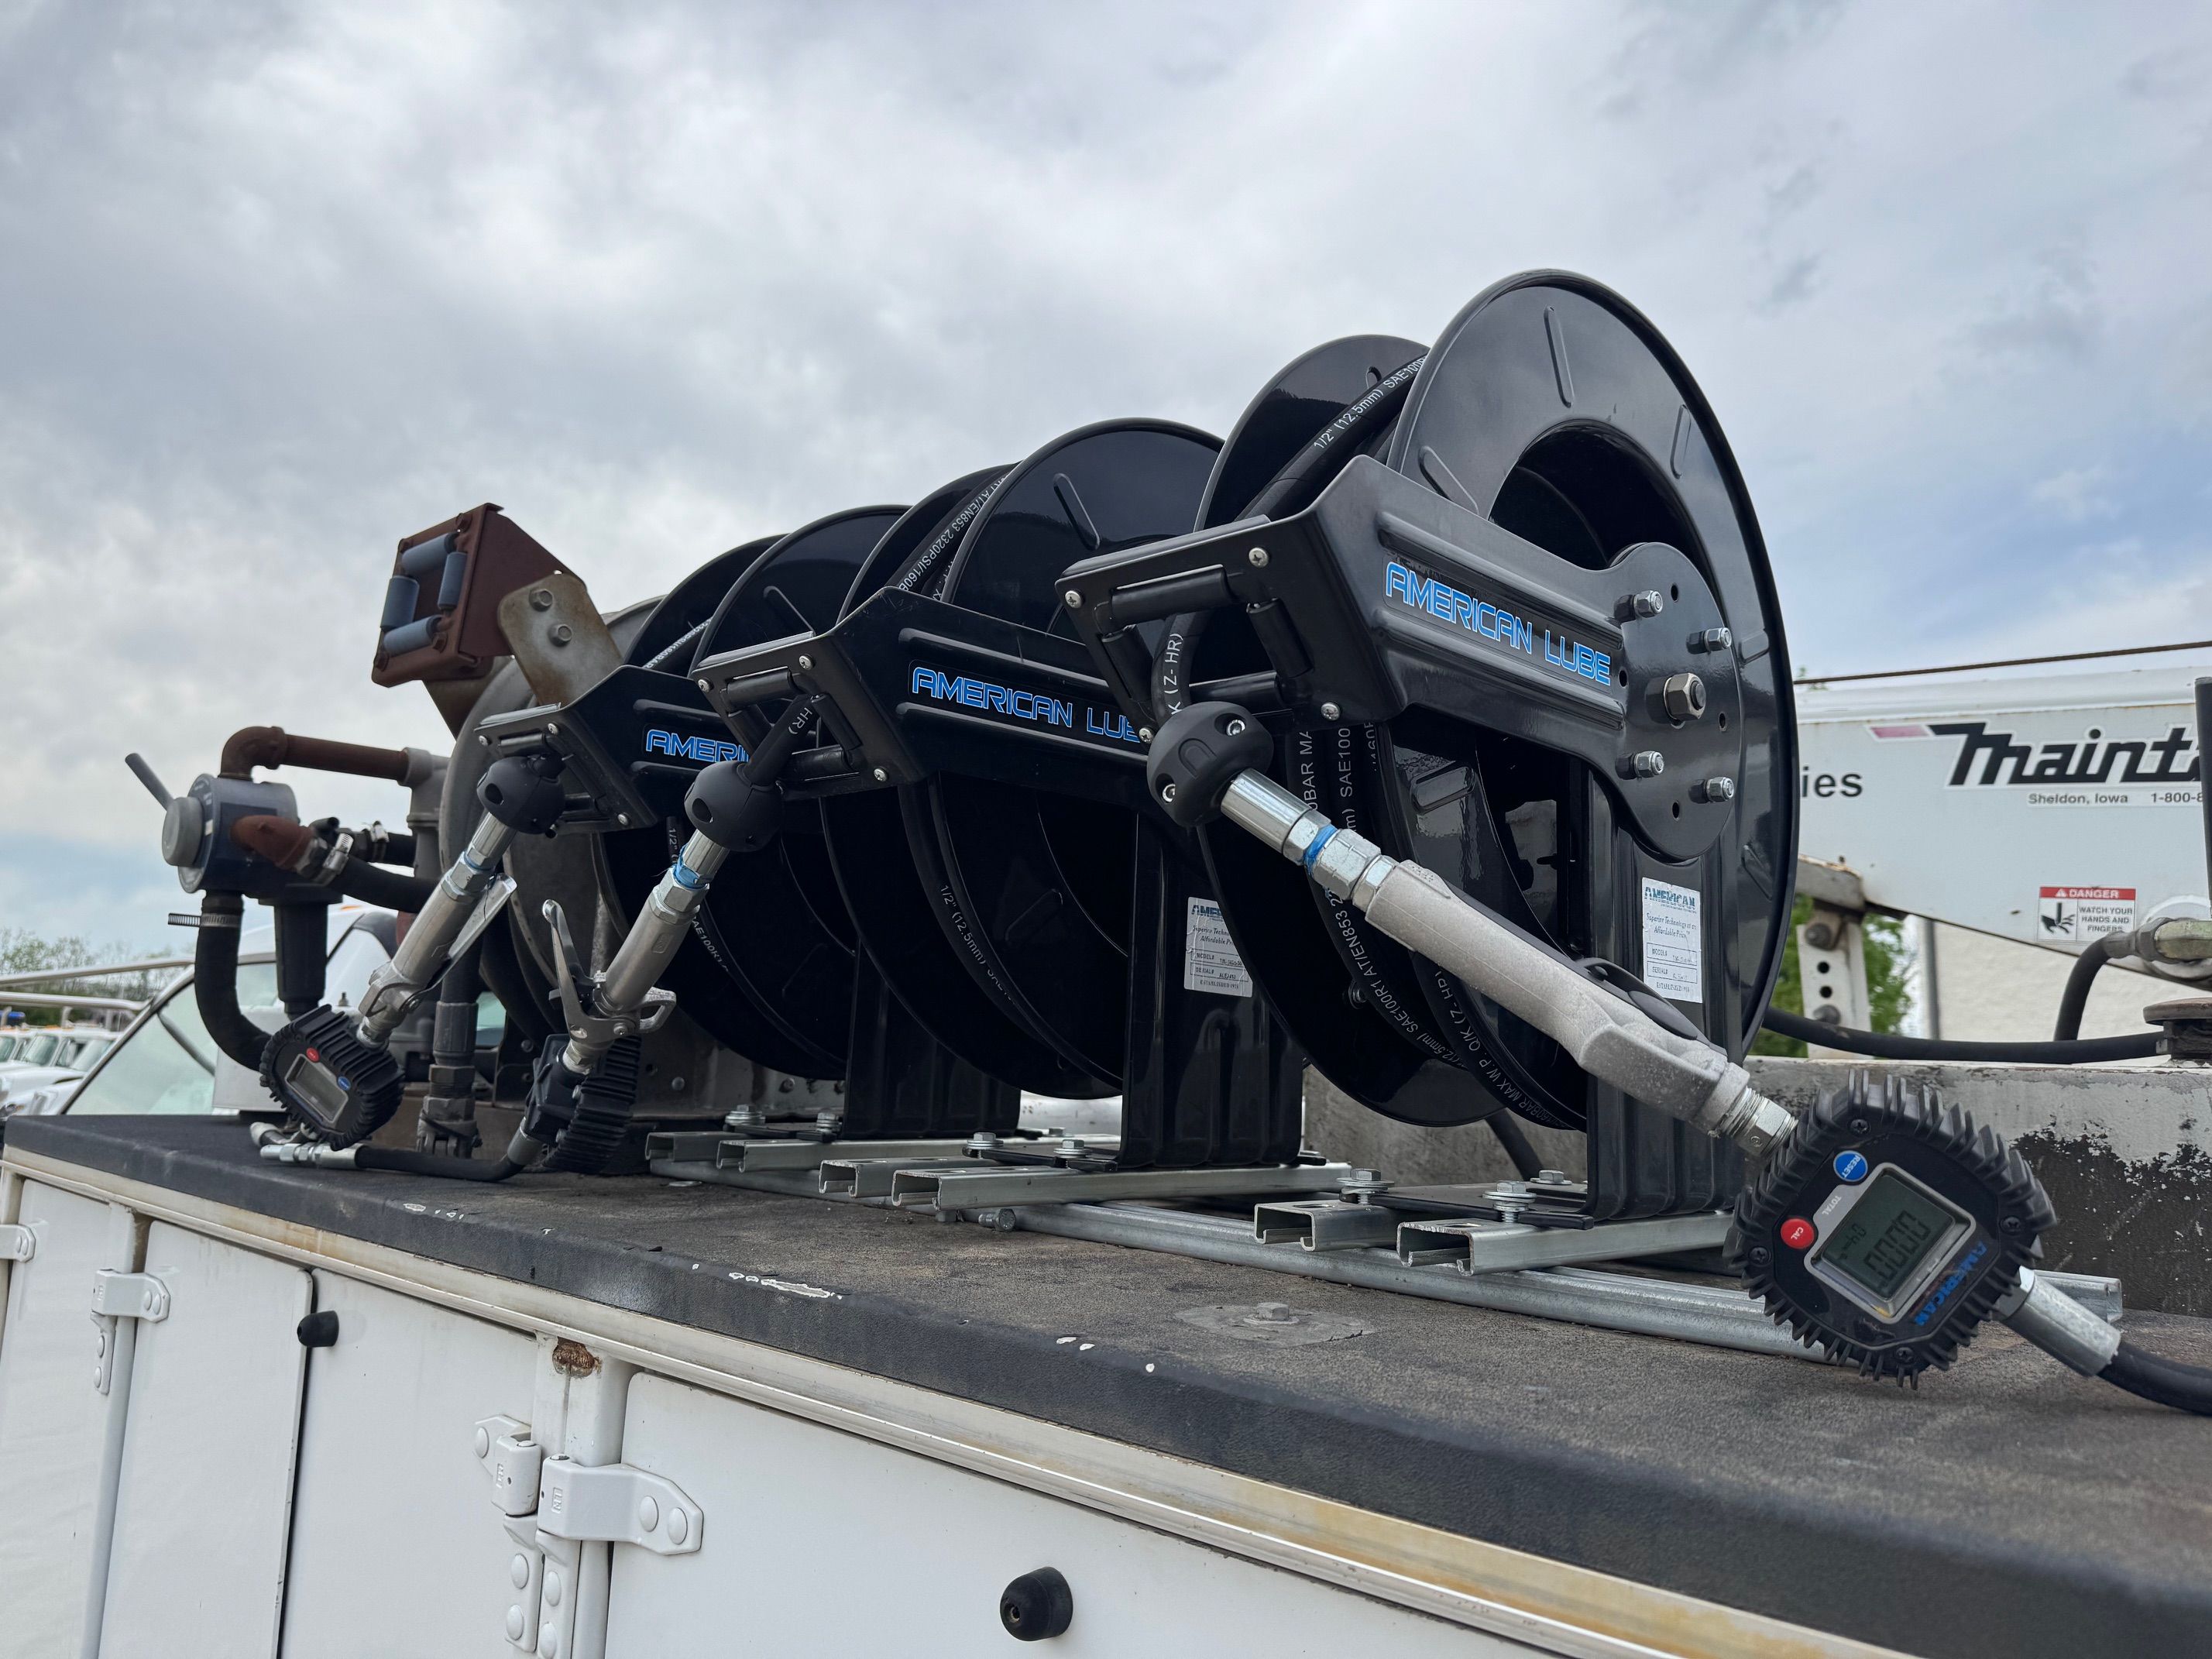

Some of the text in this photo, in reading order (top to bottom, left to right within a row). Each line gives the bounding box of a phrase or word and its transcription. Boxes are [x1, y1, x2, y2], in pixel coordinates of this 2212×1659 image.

[1314, 428, 1334, 448] 1/2"
[1334, 389, 1385, 430] (12.5mm)
[1385, 561, 1611, 686] AMERICAN LUBE
[1164, 633, 1184, 664] HR)
[912, 666, 1073, 728] AMERICAN
[645, 728, 750, 763] AMERI
[2028, 793, 2090, 805] Sheldon,
[2094, 793, 2128, 804] Iowa
[2069, 888, 2119, 898] DANGER
[940, 885, 987, 965] 1/2" (12.5mm)
[2078, 905, 2107, 914] WATCH
[1335, 910, 1377, 977] AT/EN853
[1369, 980, 1419, 1033] SAE100R1
[1496, 1078, 1524, 1102] MAX
[1842, 1155, 1861, 1178] RESET
[1821, 1195, 1842, 1215] TOTAL
[1790, 1227, 1804, 1240] CAL
